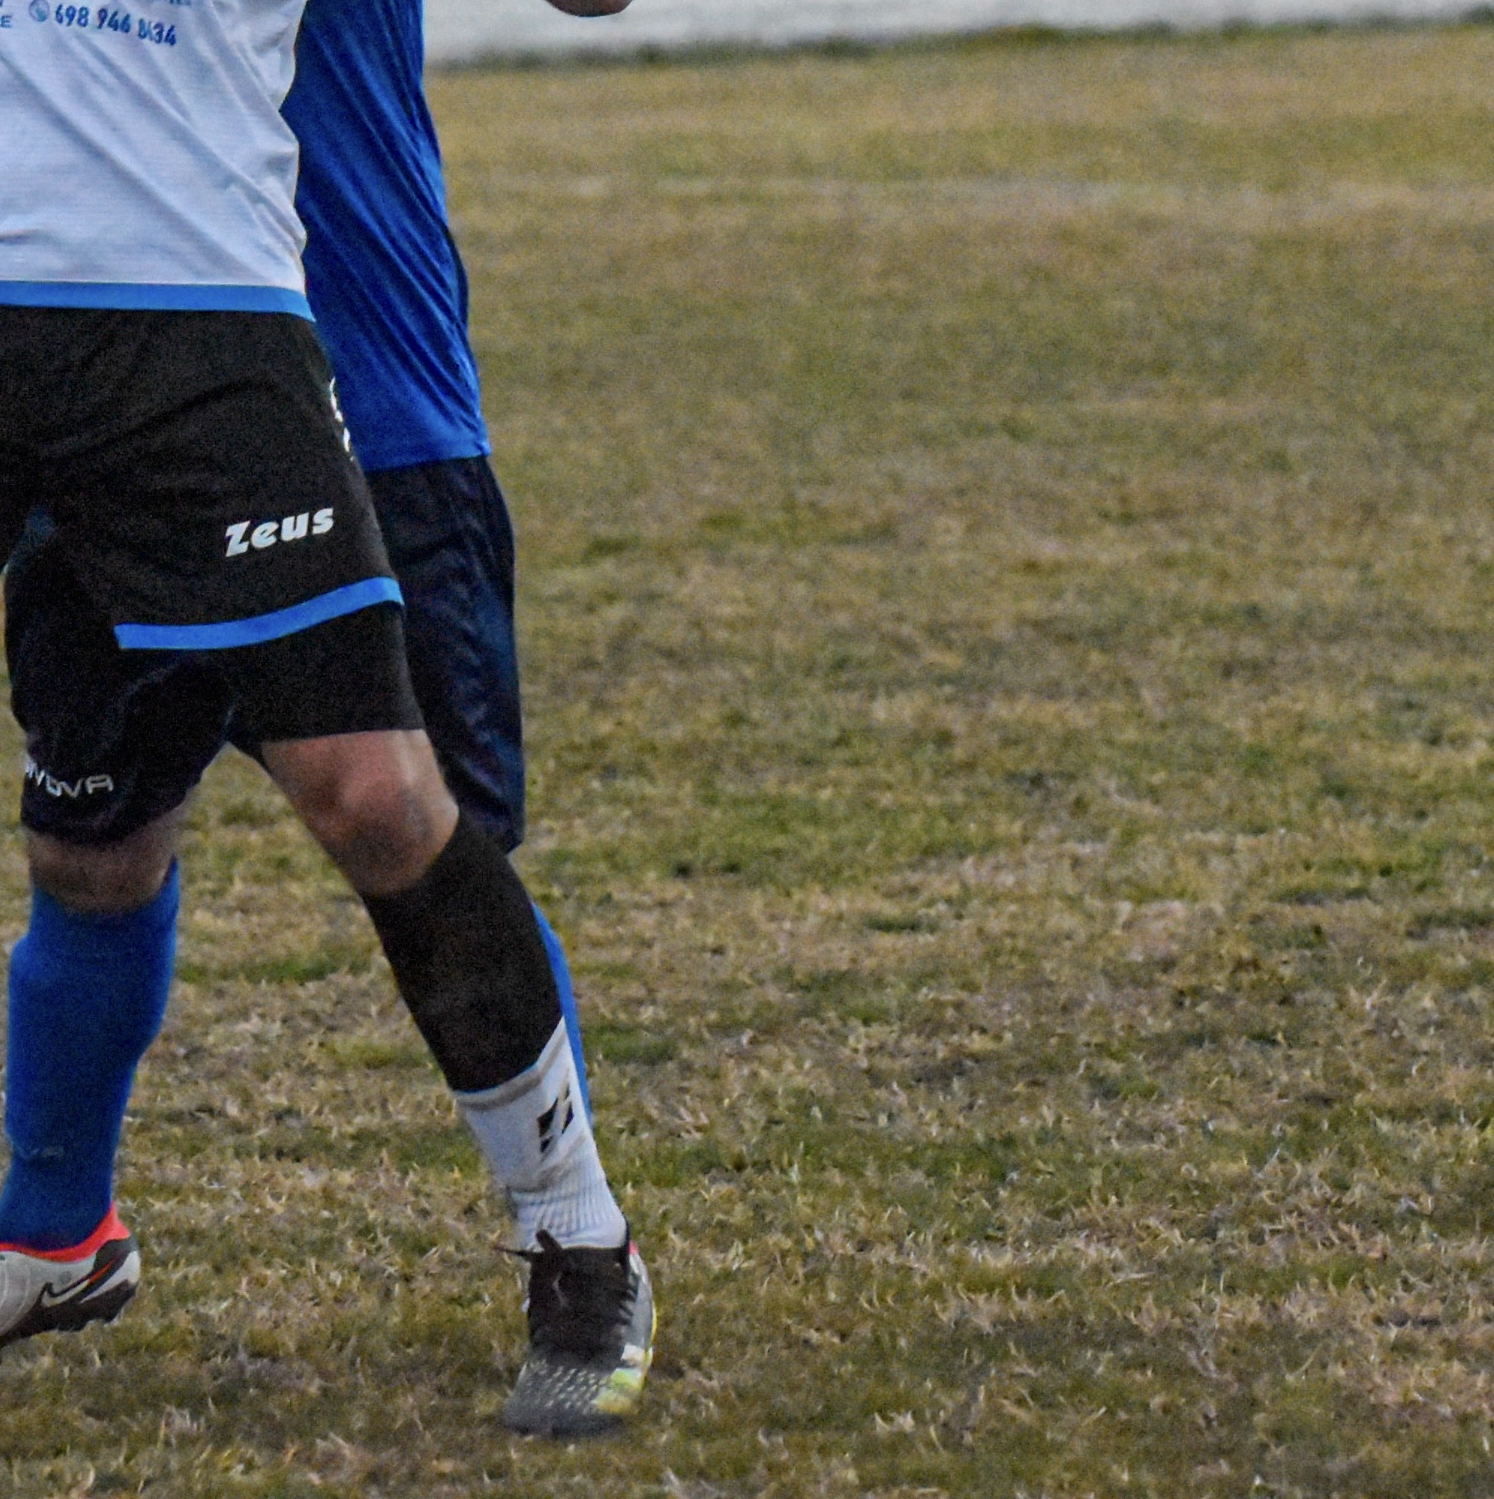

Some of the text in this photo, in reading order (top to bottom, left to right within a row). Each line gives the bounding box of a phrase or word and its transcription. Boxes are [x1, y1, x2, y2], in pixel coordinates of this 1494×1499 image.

[55, 4, 89, 28] 698
[97, 8, 131, 34] 946
[225, 507, 335, 558] Zeus
